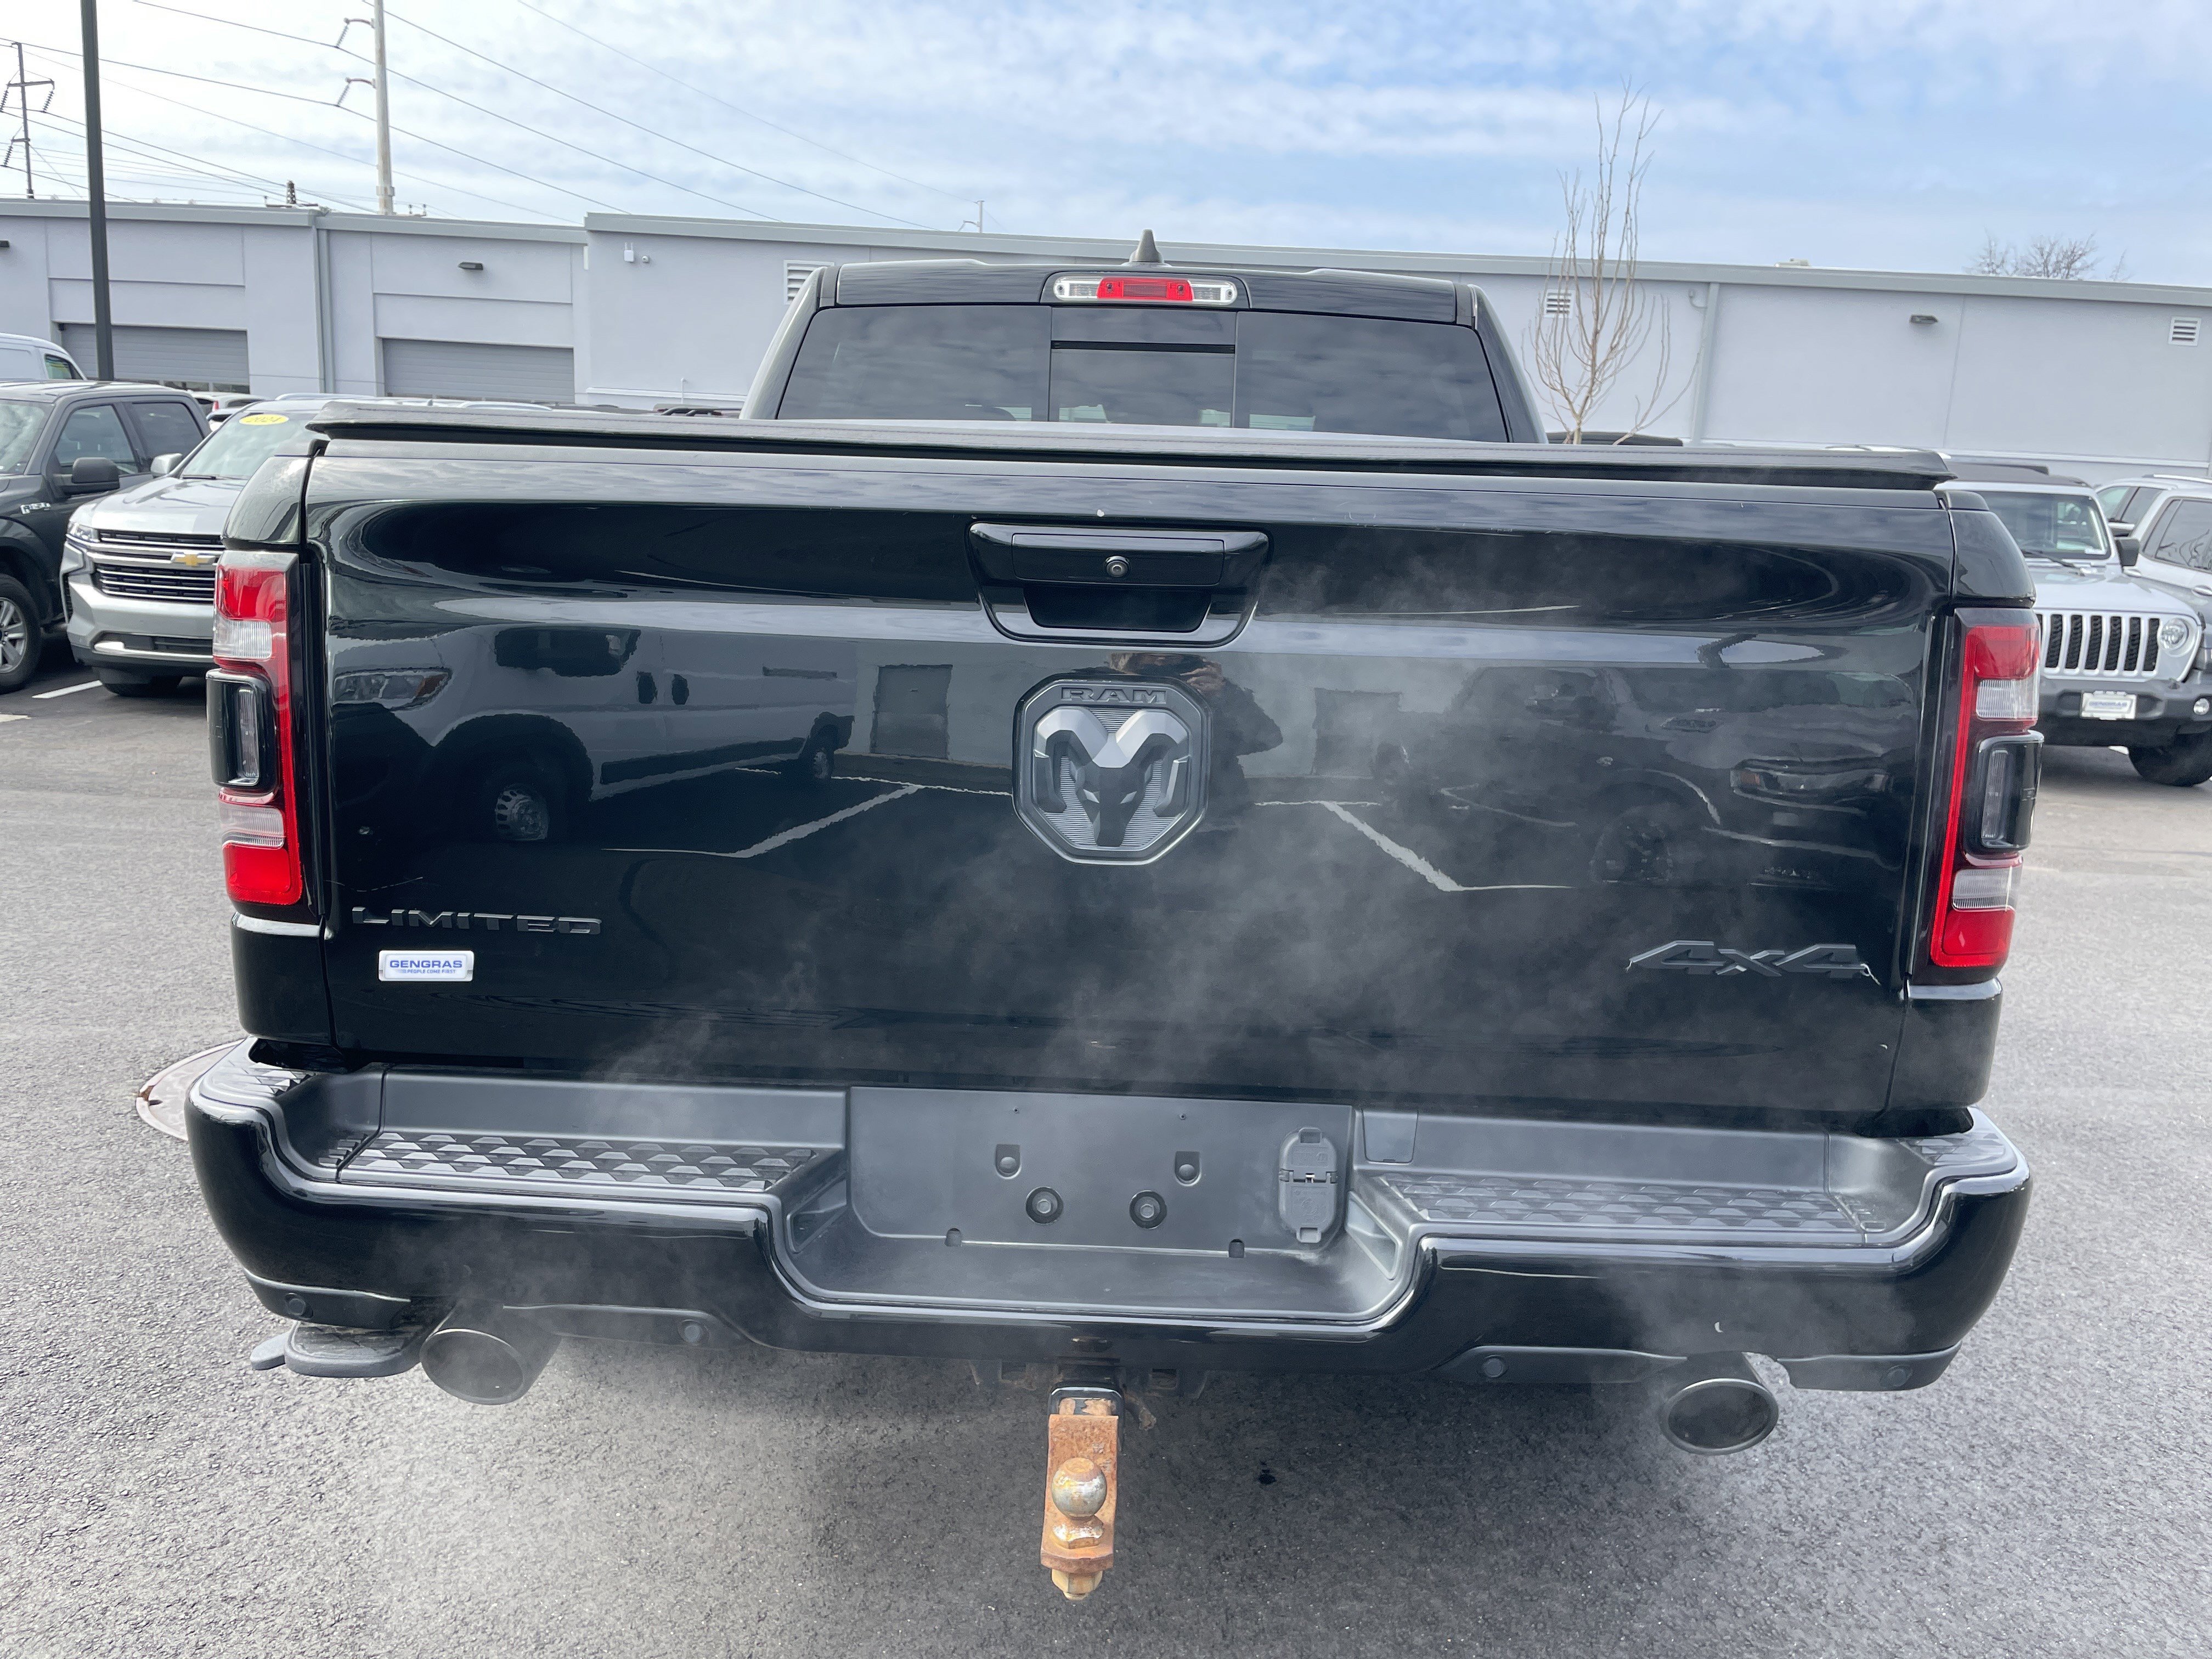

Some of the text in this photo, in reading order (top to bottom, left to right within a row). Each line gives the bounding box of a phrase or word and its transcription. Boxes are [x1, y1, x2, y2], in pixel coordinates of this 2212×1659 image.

[1060, 686, 1167, 704] RAM
[352, 906, 602, 934] LIMITED
[390, 960, 462, 968] GENGRAS
